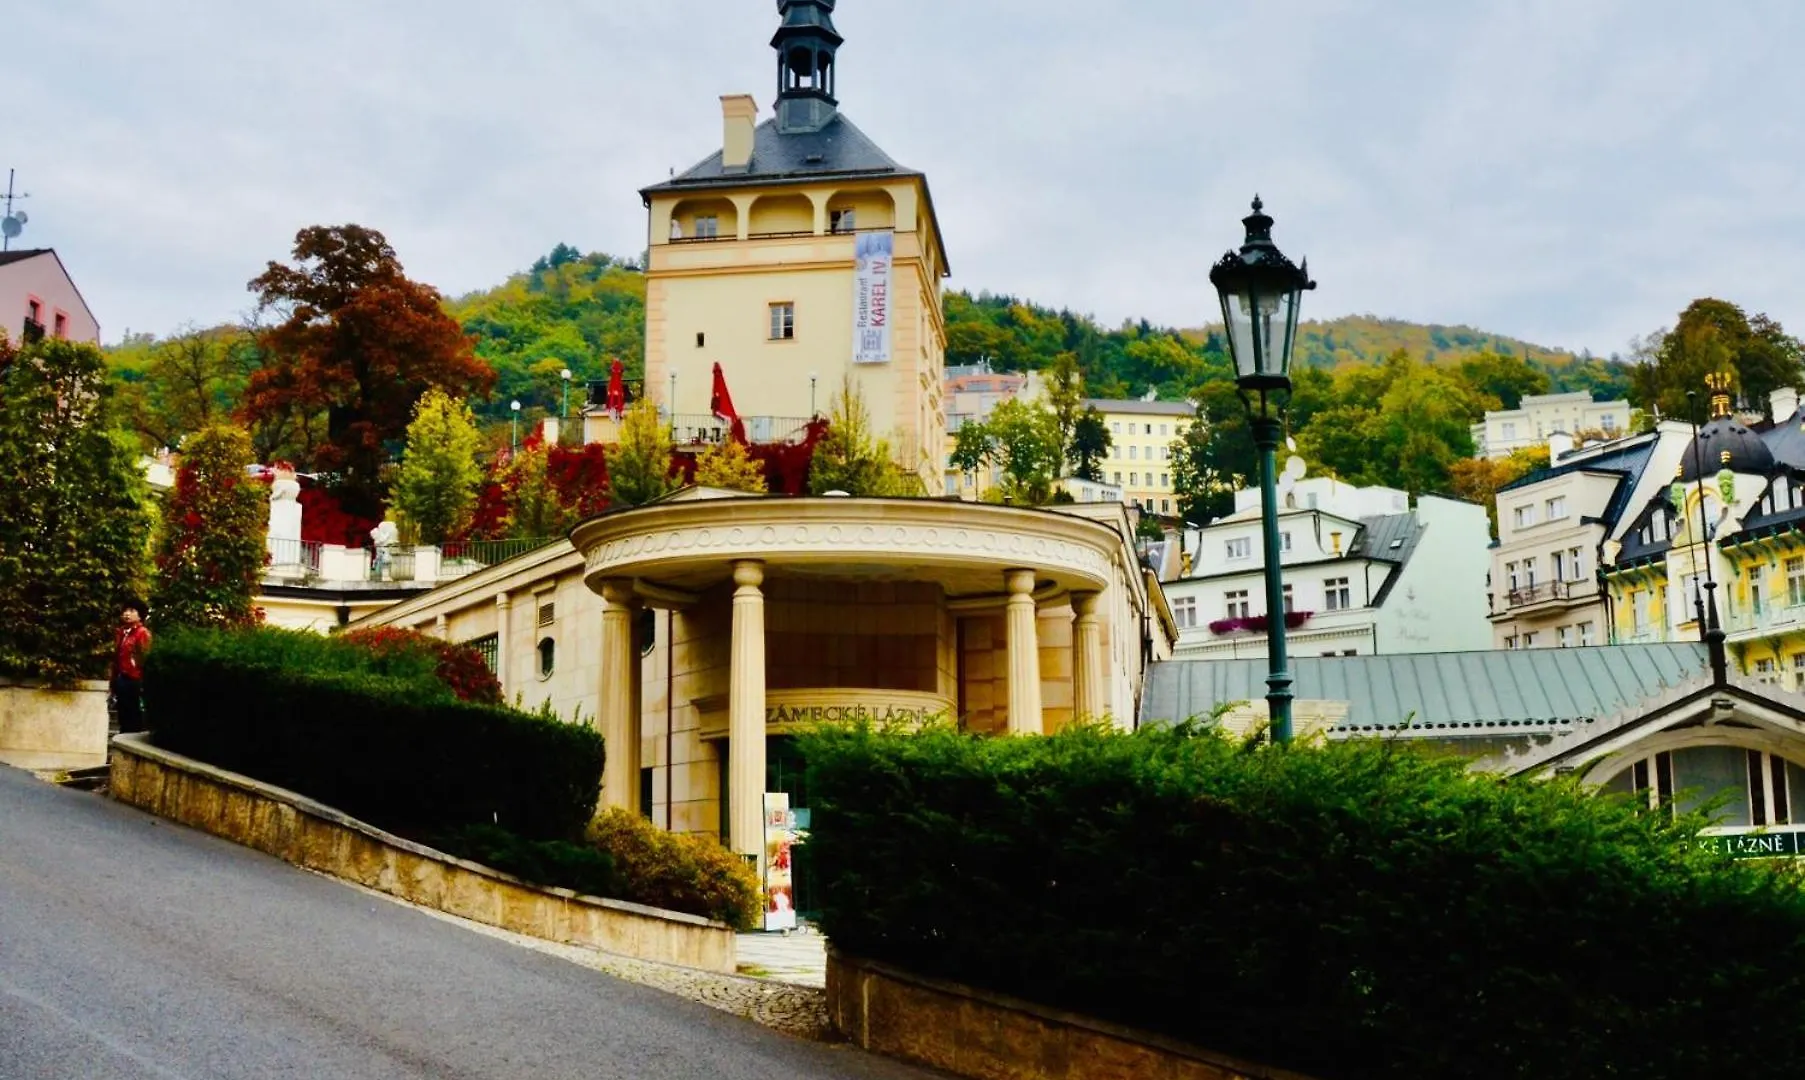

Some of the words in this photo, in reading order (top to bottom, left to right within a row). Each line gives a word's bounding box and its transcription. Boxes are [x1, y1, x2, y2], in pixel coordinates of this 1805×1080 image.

[872, 260, 886, 275] IV
[857, 278, 868, 328] Restaurant
[871, 280, 886, 327] KAREL
[1726, 834, 1784, 854] LÁZNĚ
